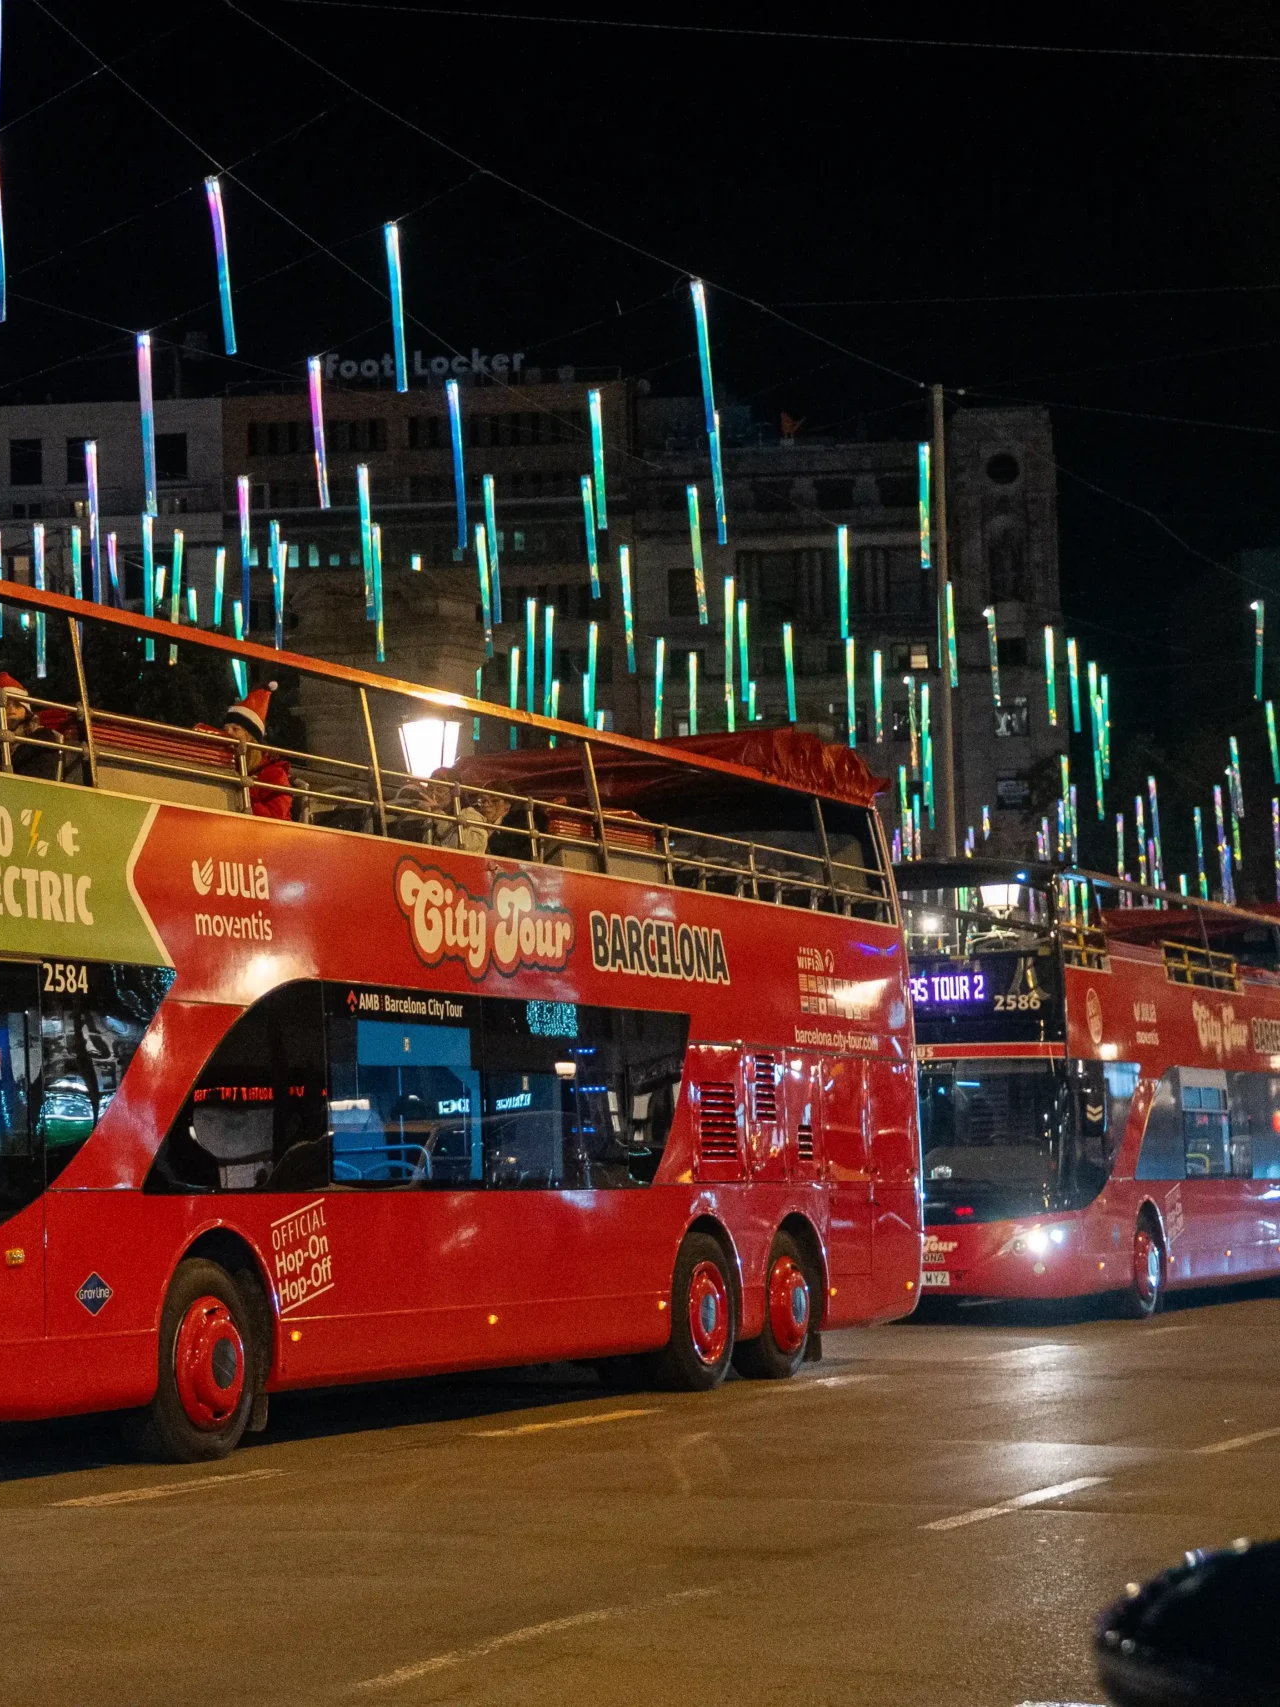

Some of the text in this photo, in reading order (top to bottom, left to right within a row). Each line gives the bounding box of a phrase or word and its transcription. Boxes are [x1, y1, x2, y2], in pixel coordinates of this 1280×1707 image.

[324, 348, 525, 380] Foot Locker
[194, 911, 273, 941] moventis
[399, 868, 732, 986] City Tour BARCELONA
[42, 962, 89, 995] 2584
[797, 956, 816, 971] WIFI
[931, 975, 970, 1001] TOUR
[973, 974, 985, 999] 2
[993, 994, 1041, 1012] 2586
[359, 993, 464, 1020] AMB Barcelona City Tour
[271, 1206, 327, 1251] OFFICIAL
[275, 1235, 329, 1279] Hop-On
[278, 1255, 332, 1306] Hop-Off
